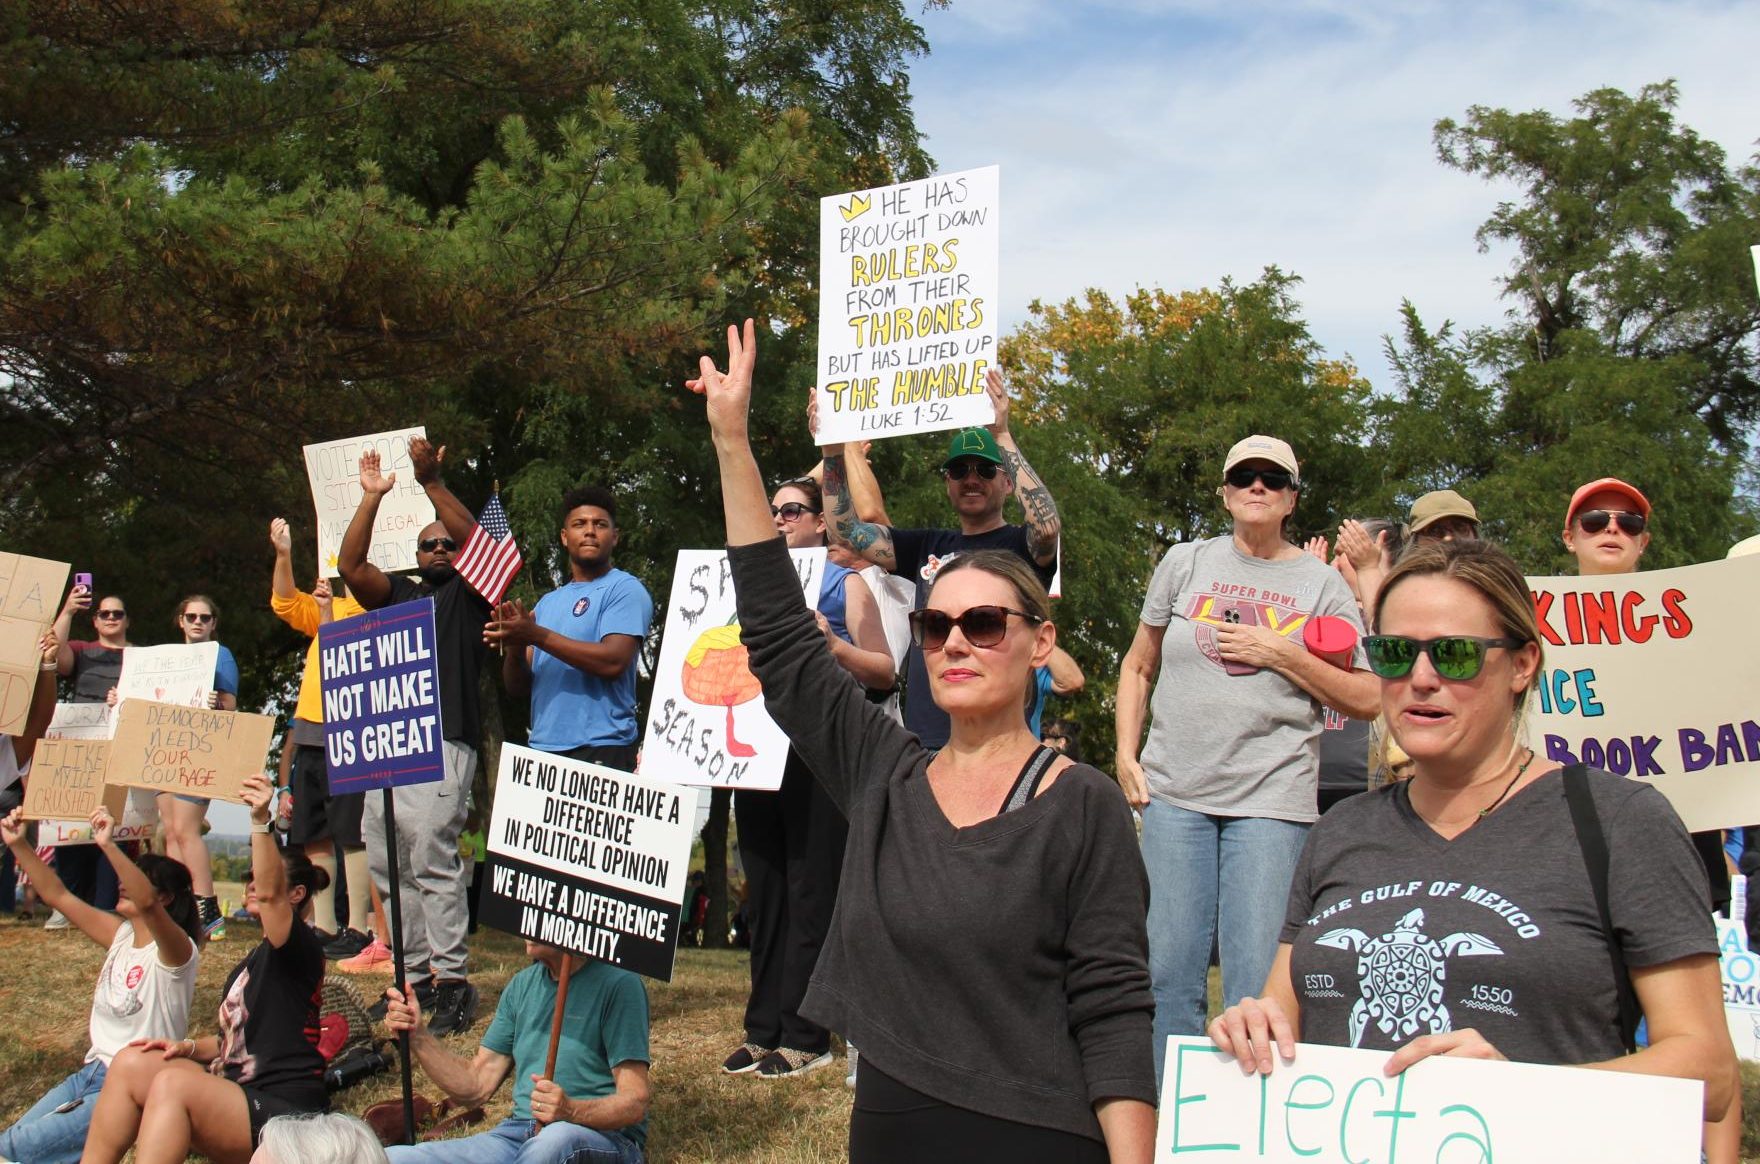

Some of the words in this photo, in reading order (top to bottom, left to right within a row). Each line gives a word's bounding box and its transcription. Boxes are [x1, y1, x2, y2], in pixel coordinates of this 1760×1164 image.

[882, 188, 911, 216] HE
[925, 178, 968, 209] HAS
[840, 214, 929, 253] BROUGHT
[938, 207, 987, 231] DOWN
[852, 239, 959, 288] RULERS
[846, 285, 896, 315] FROM
[908, 274, 972, 304] THEIR
[848, 298, 984, 348] THRONES
[828, 352, 862, 376] BUT
[872, 349, 900, 370] HAS
[907, 341, 959, 366] LIFTED
[965, 335, 992, 355] UP
[825, 376, 880, 413] THE
[891, 359, 988, 406] HUMBLE
[860, 412, 902, 431] LUKE
[914, 403, 953, 425] 1:52
[306, 443, 360, 482] VOTE
[1211, 581, 1257, 598] SUPER
[1261, 590, 1297, 608] BOWL
[1530, 588, 1693, 646] KINGS
[322, 638, 373, 681] HATE
[376, 626, 431, 668] WILL
[324, 683, 364, 724] NOT
[369, 669, 434, 715] MAKE
[1539, 668, 1605, 718] ICE
[146, 705, 235, 739] DEMOCRACY
[150, 727, 213, 753] NEEDS
[327, 729, 356, 768] US
[361, 715, 436, 762] GREAT
[653, 698, 748, 784] SEASON
[38, 743, 58, 767] I
[62, 743, 105, 770] LIKE
[141, 765, 217, 787] COURAGE
[144, 746, 192, 766] YOUR
[1544, 733, 1666, 777] BOOK
[32, 785, 96, 815] CRUSHED
[52, 767, 71, 789] MY
[70, 769, 97, 789] ICE
[512, 755, 532, 787] WE
[536, 762, 557, 791] NO
[560, 768, 619, 809] LONGER
[623, 784, 666, 821] HAVE
[667, 796, 680, 824] A
[543, 796, 635, 846] DIFFERENCE
[504, 818, 521, 848] IN
[523, 823, 597, 870] POLITICAL
[601, 845, 669, 889] OPINION
[492, 864, 516, 898] WE
[516, 873, 557, 910] HAVE
[557, 885, 570, 915] A
[572, 888, 669, 943] DIFFERENCE
[1307, 898, 1352, 927] THE
[1360, 881, 1423, 904] GULF
[1428, 881, 1461, 897] OF
[1460, 885, 1541, 940] MEXICO
[520, 906, 538, 937] IN
[540, 912, 621, 964] MORALITY.
[1304, 974, 1335, 990] ESTD
[1471, 984, 1513, 1004] 1550
